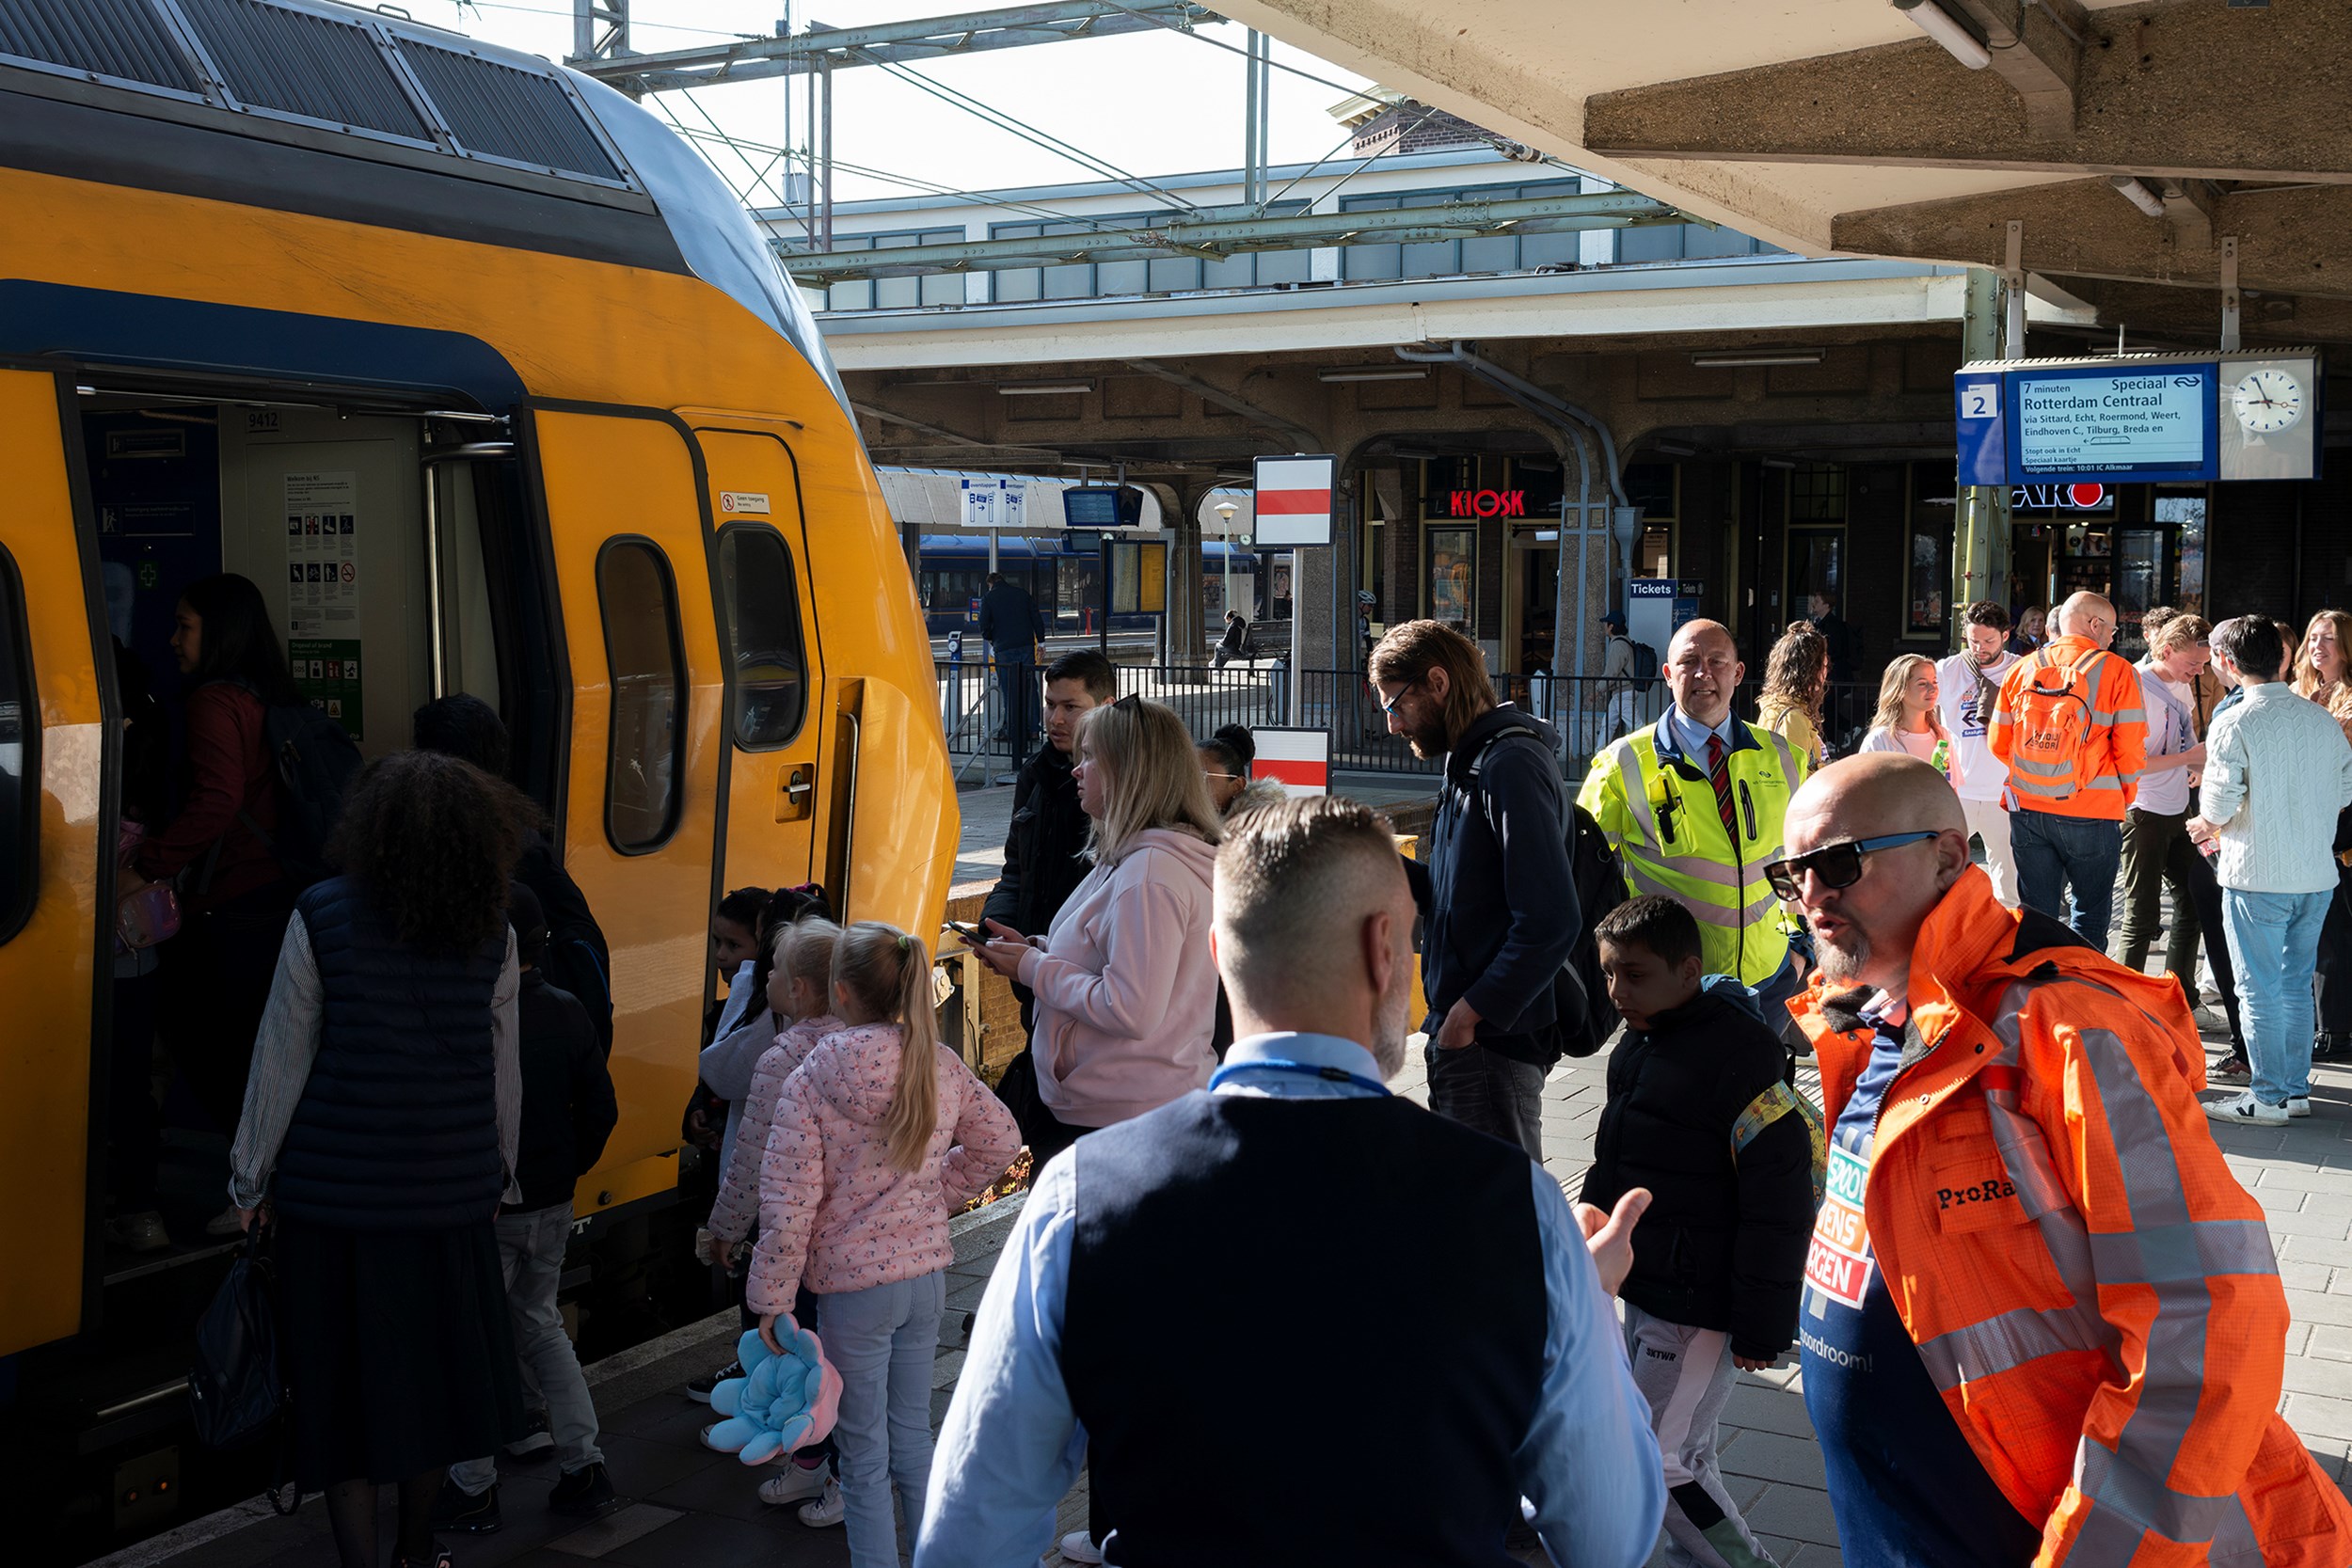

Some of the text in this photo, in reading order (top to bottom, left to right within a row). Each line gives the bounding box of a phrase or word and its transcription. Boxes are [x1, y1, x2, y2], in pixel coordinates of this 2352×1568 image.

[2024, 377, 2167, 393] 7 minuten Speciaal
[1973, 396, 1986, 414] 2
[2025, 393, 2162, 410] Rotterdam Centraal
[248, 413, 278, 427] 9412
[2040, 414, 2072, 423] Sittard,
[2075, 414, 2096, 422] Echt,
[2099, 412, 2148, 421] Roermond,
[2151, 411, 2181, 420] Weert,
[2025, 427, 2071, 436] Eindhoven
[2087, 425, 2121, 436] Tilburg,
[2123, 424, 2150, 434] Breda
[1451, 489, 1525, 517] KIOSK
[1630, 583, 1672, 594] Tickets
[1806, 1241, 1852, 1293] AGEN
